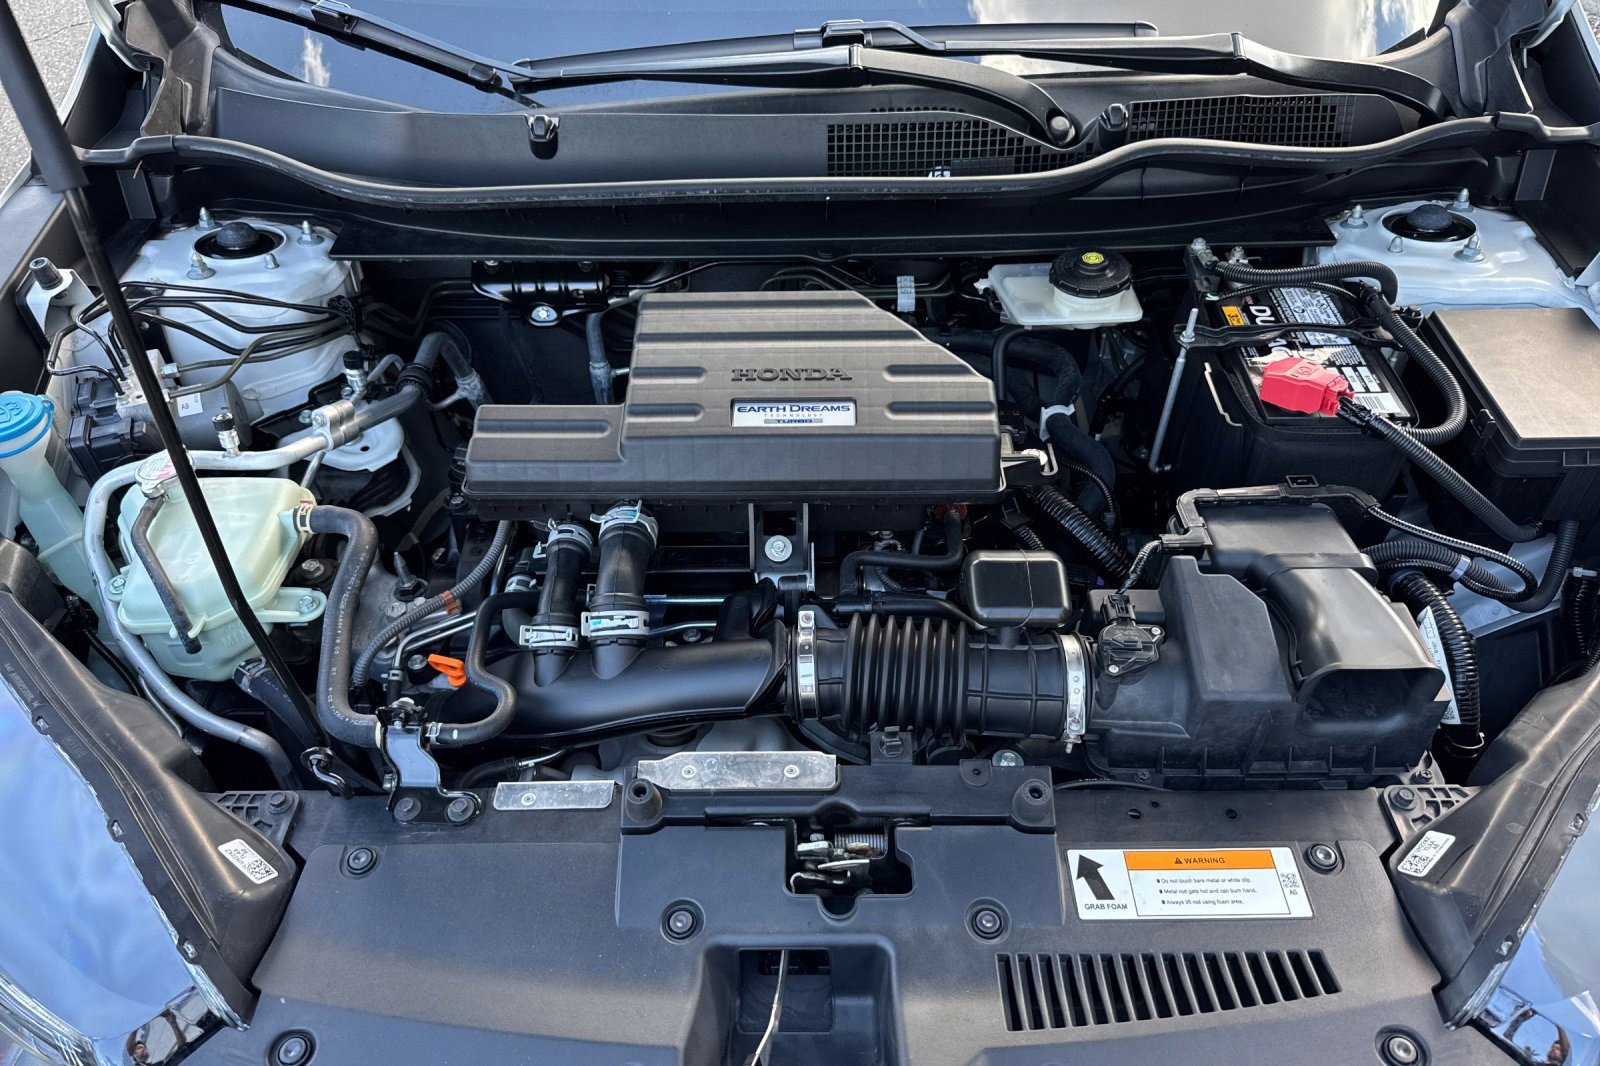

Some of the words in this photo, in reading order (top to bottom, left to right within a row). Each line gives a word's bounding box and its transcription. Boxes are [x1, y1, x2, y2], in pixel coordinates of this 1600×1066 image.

[731, 368, 852, 381] HONDA
[789, 404, 850, 412] DREAMS
[1183, 857, 1226, 865] WARNING
[1084, 903, 1106, 911] GRAB
